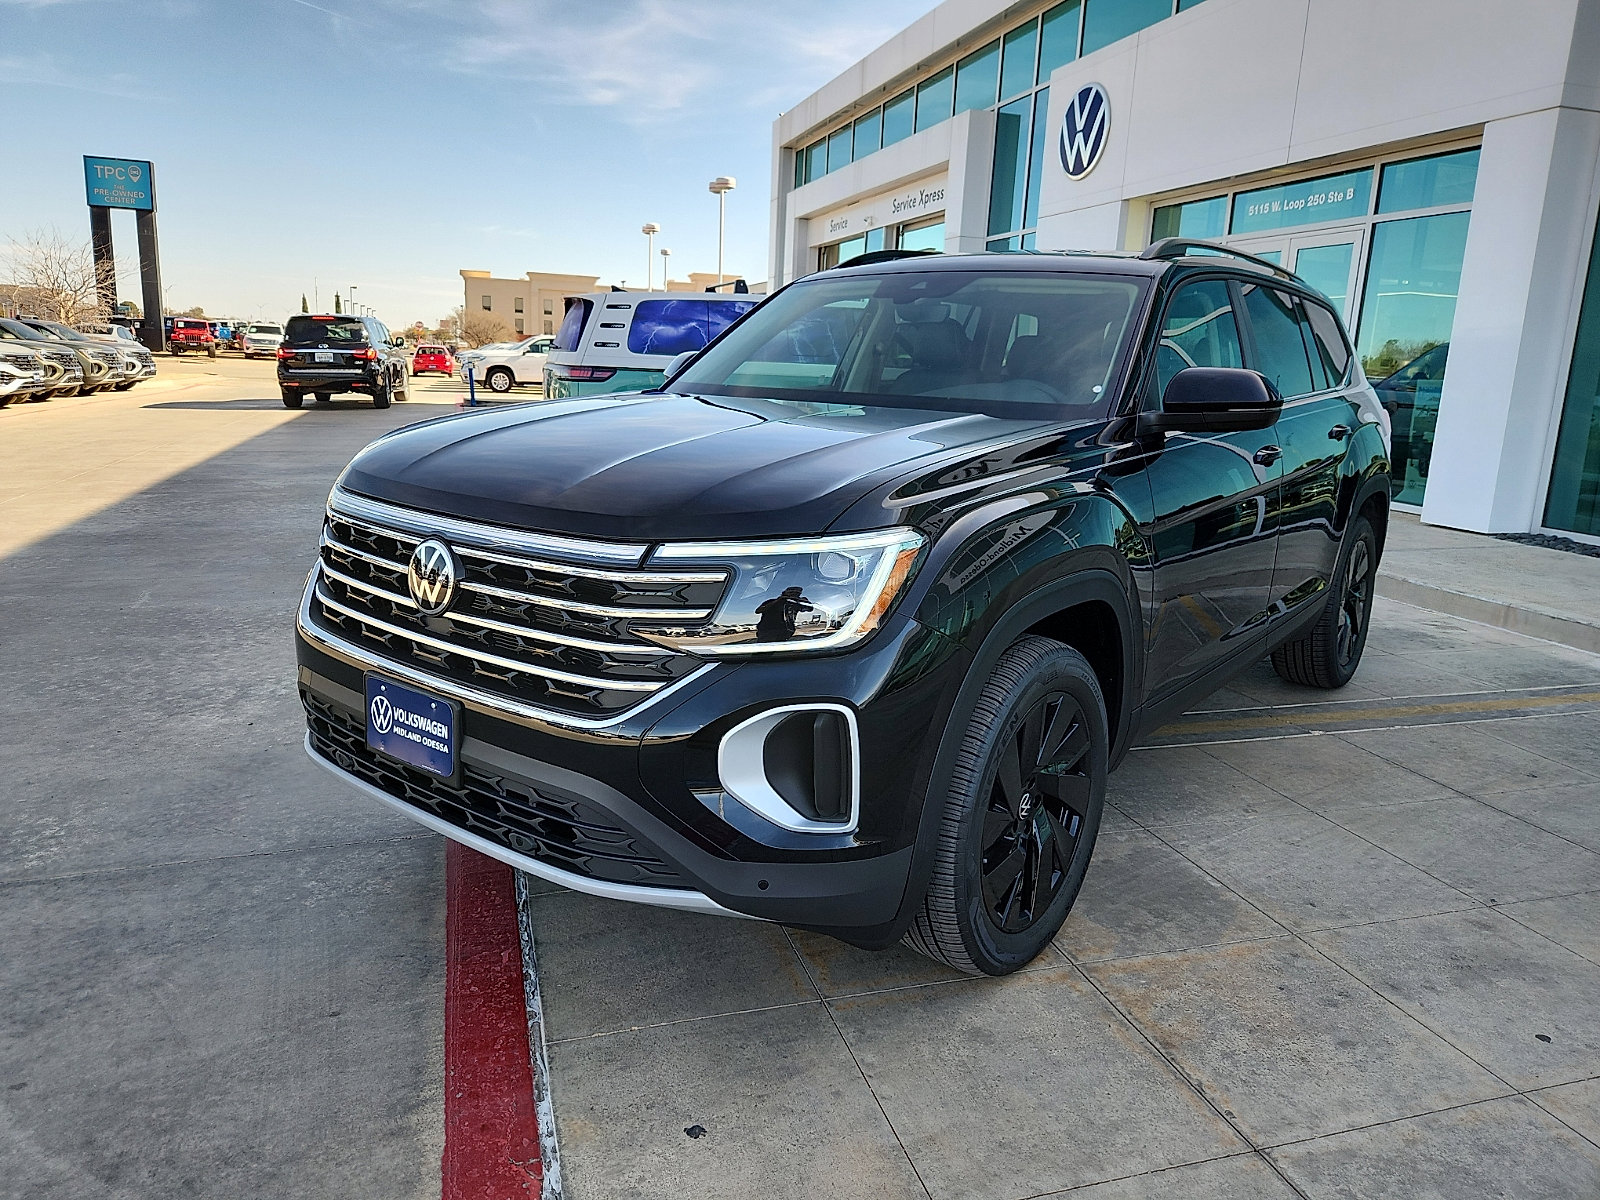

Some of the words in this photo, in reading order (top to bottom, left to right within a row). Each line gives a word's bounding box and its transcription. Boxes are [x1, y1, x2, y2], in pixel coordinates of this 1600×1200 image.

[94, 165, 125, 180] TPC
[94, 188, 145, 198] PRE-OWNED
[104, 196, 136, 204] CENTER
[892, 195, 916, 214] Service
[918, 188, 945, 209] Xpress
[1248, 203, 1269, 216] 5115
[1271, 201, 1281, 212] W.
[1284, 199, 1305, 211] Loop
[1307, 193, 1326, 207] 250
[1327, 191, 1344, 203] Ste
[1346, 188, 1354, 200] B
[829, 217, 848, 232] Service
[393, 706, 449, 740] VOLKSWAGEN
[393, 725, 422, 743] MIDLAND
[422, 736, 449, 754] ODESSA
